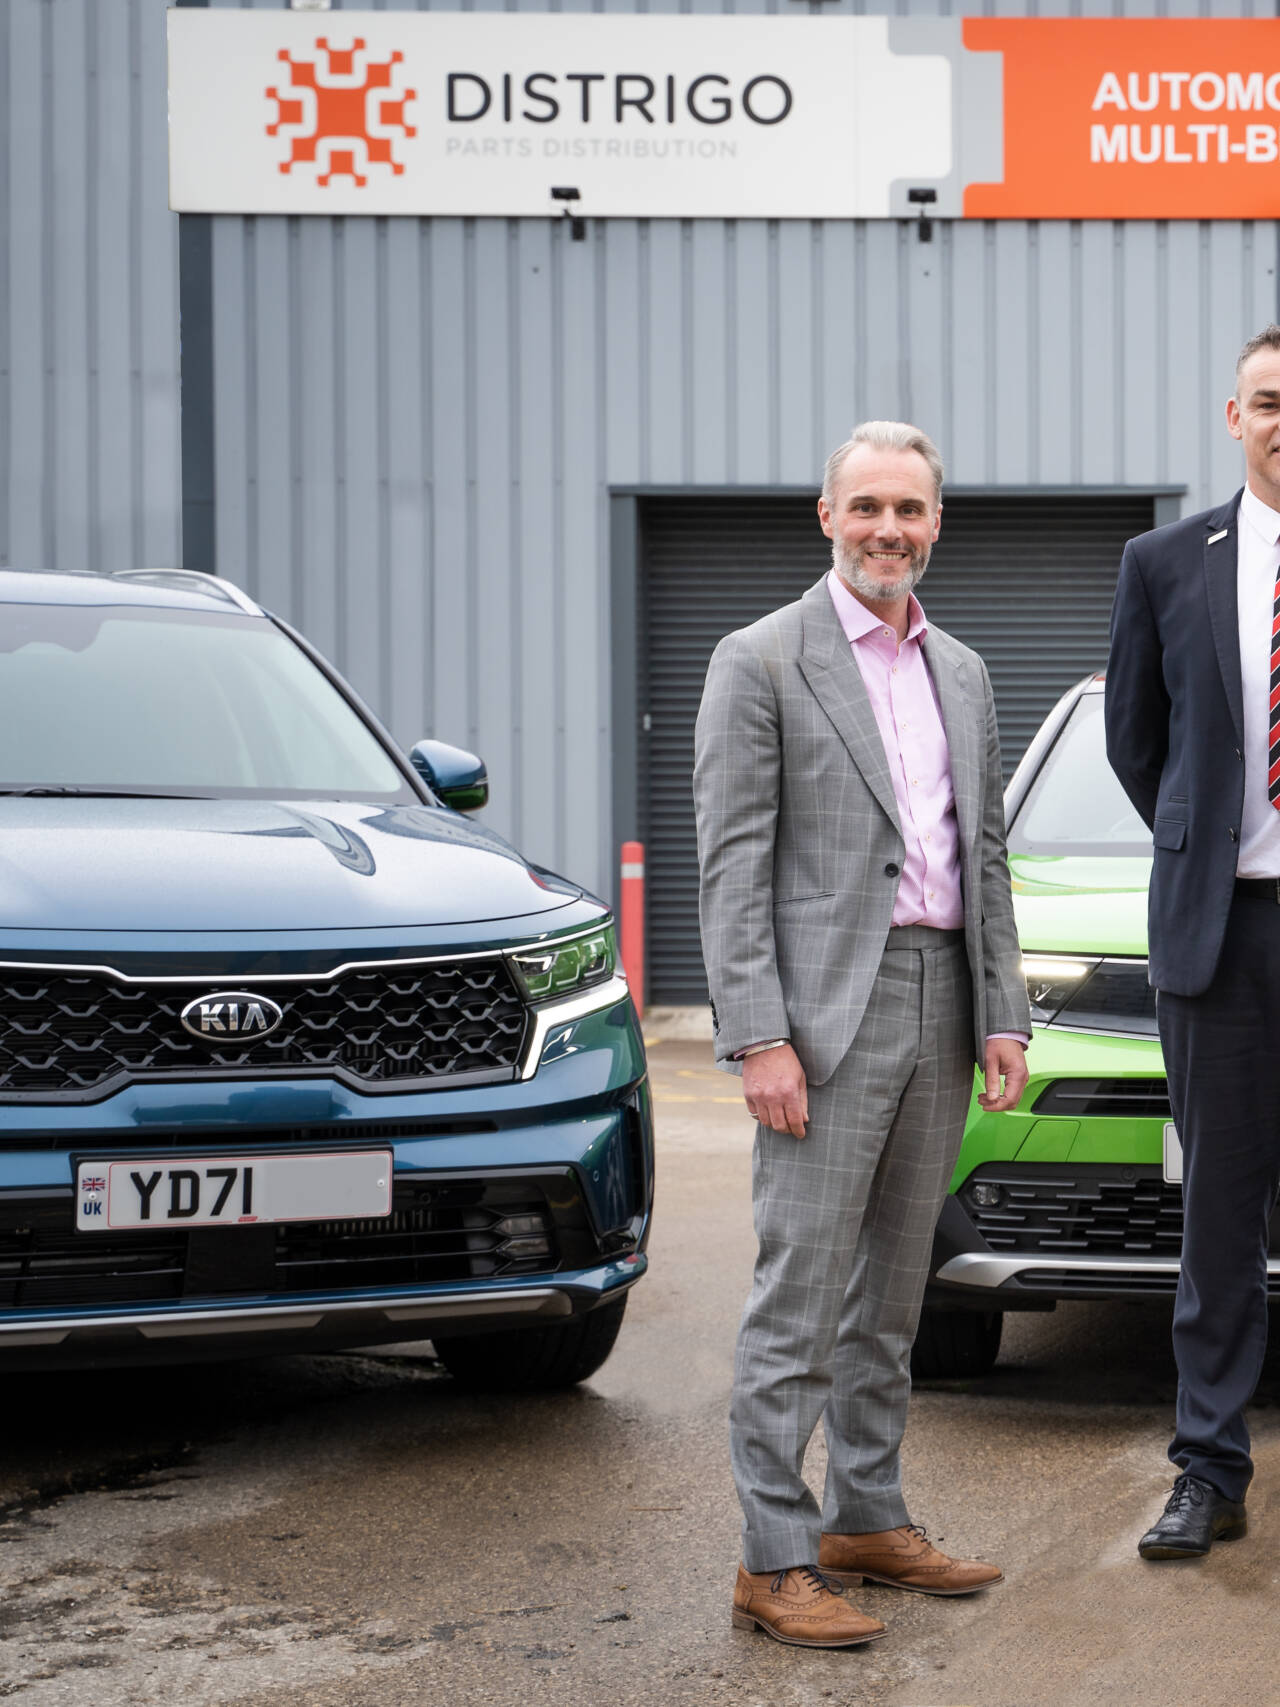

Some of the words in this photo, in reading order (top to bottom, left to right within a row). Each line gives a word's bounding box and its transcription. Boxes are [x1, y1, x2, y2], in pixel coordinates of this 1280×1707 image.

[447, 72, 793, 125] DISTRIGO
[446, 138, 533, 157] PARTS
[543, 138, 738, 158] DISTRIBUTION
[200, 1003, 267, 1031] KIA
[130, 1167, 253, 1220] YD71
[83, 1202, 102, 1216] UK
